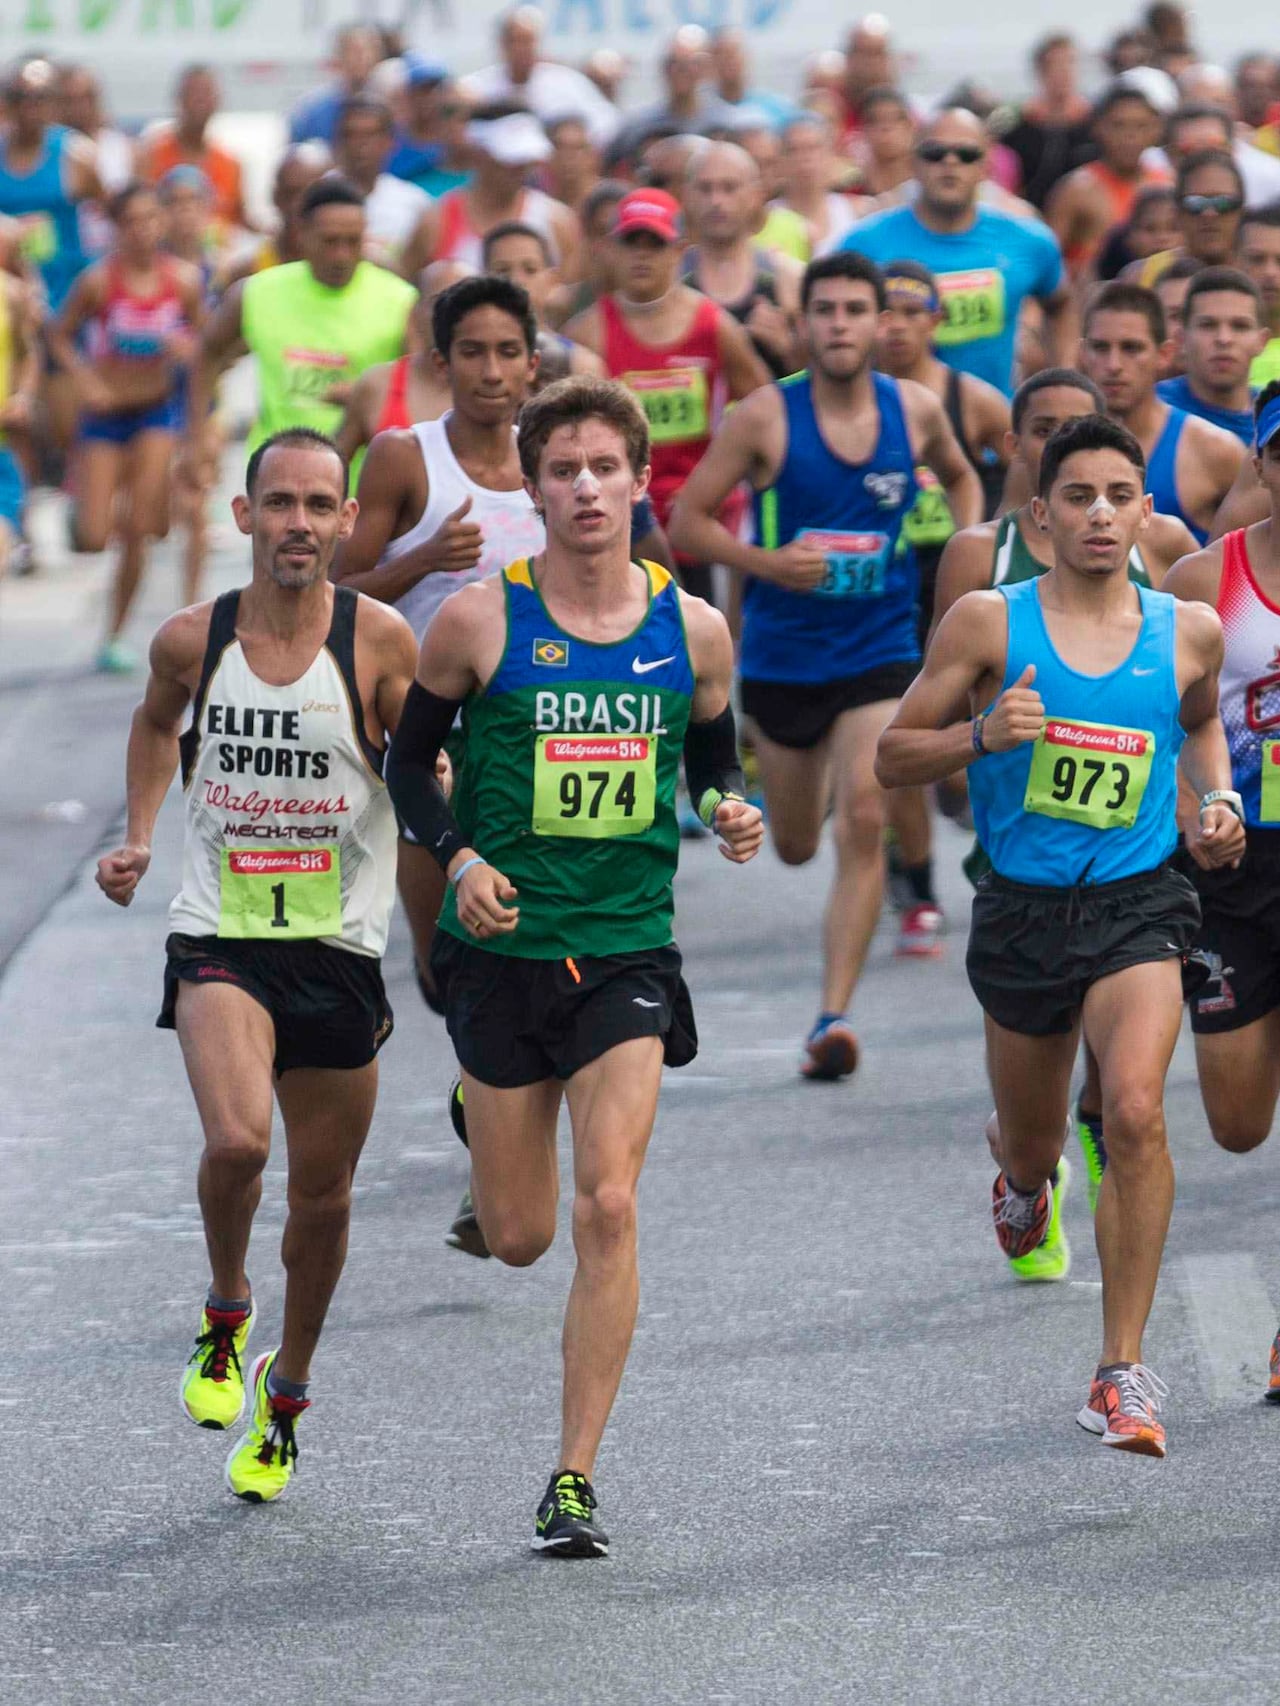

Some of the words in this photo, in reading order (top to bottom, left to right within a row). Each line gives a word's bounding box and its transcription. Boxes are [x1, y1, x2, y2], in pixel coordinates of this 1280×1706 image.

[208, 704, 300, 740] ELITE
[535, 691, 667, 734] BRASIL
[553, 742, 618, 758] Walgreens
[619, 741, 641, 758] 5K
[1054, 726, 1116, 747] Walgreens
[1117, 735, 1139, 752] 5K
[219, 743, 329, 779] SPORTS
[204, 779, 349, 821] Walgreens
[559, 771, 636, 819] 974
[1051, 756, 1130, 809] 973
[223, 821, 339, 839] MECH-TECH
[236, 851, 299, 869] Walgreens
[300, 854, 323, 870] 5K
[271, 882, 289, 928] 1
